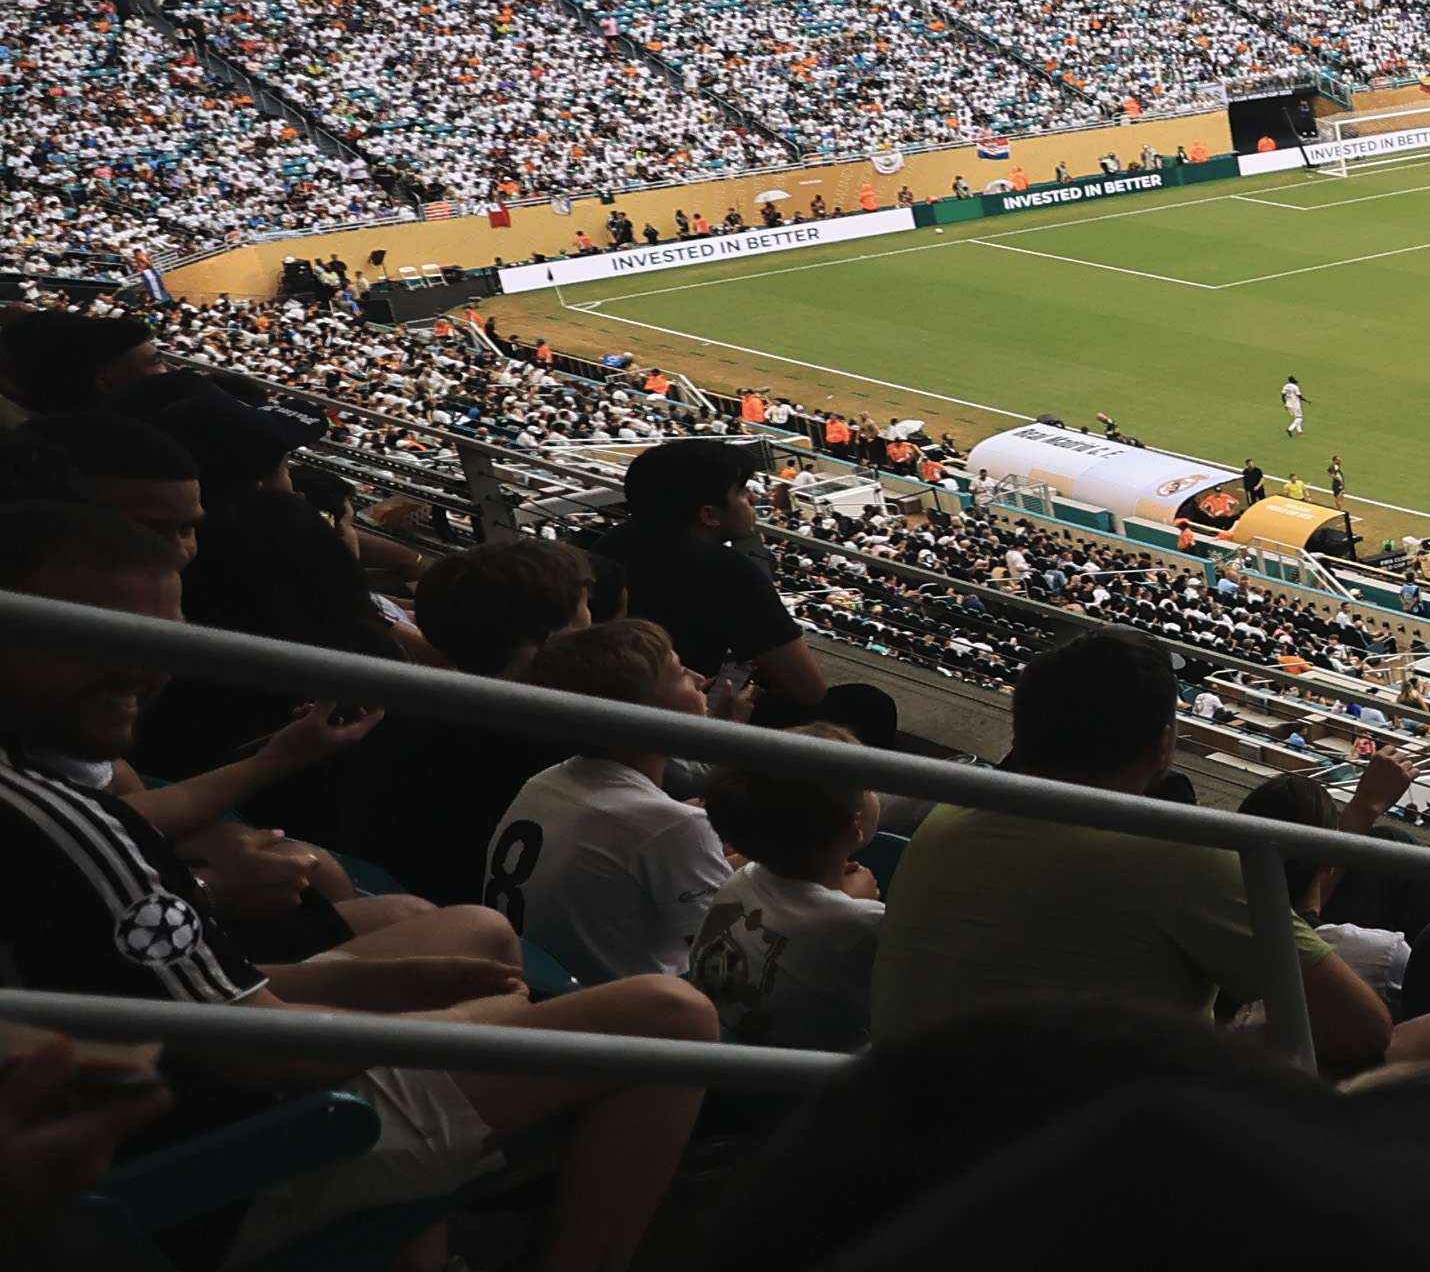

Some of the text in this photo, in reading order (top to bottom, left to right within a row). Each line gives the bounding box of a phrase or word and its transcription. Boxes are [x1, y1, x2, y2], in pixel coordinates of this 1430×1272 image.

[1310, 135, 1378, 162] INVESTED
[1381, 134, 1394, 150] IN
[1003, 174, 1163, 210] INVESTED IN BETTER
[612, 227, 820, 271] INVESTED IN BETTER
[1042, 436, 1095, 453] Madrid
